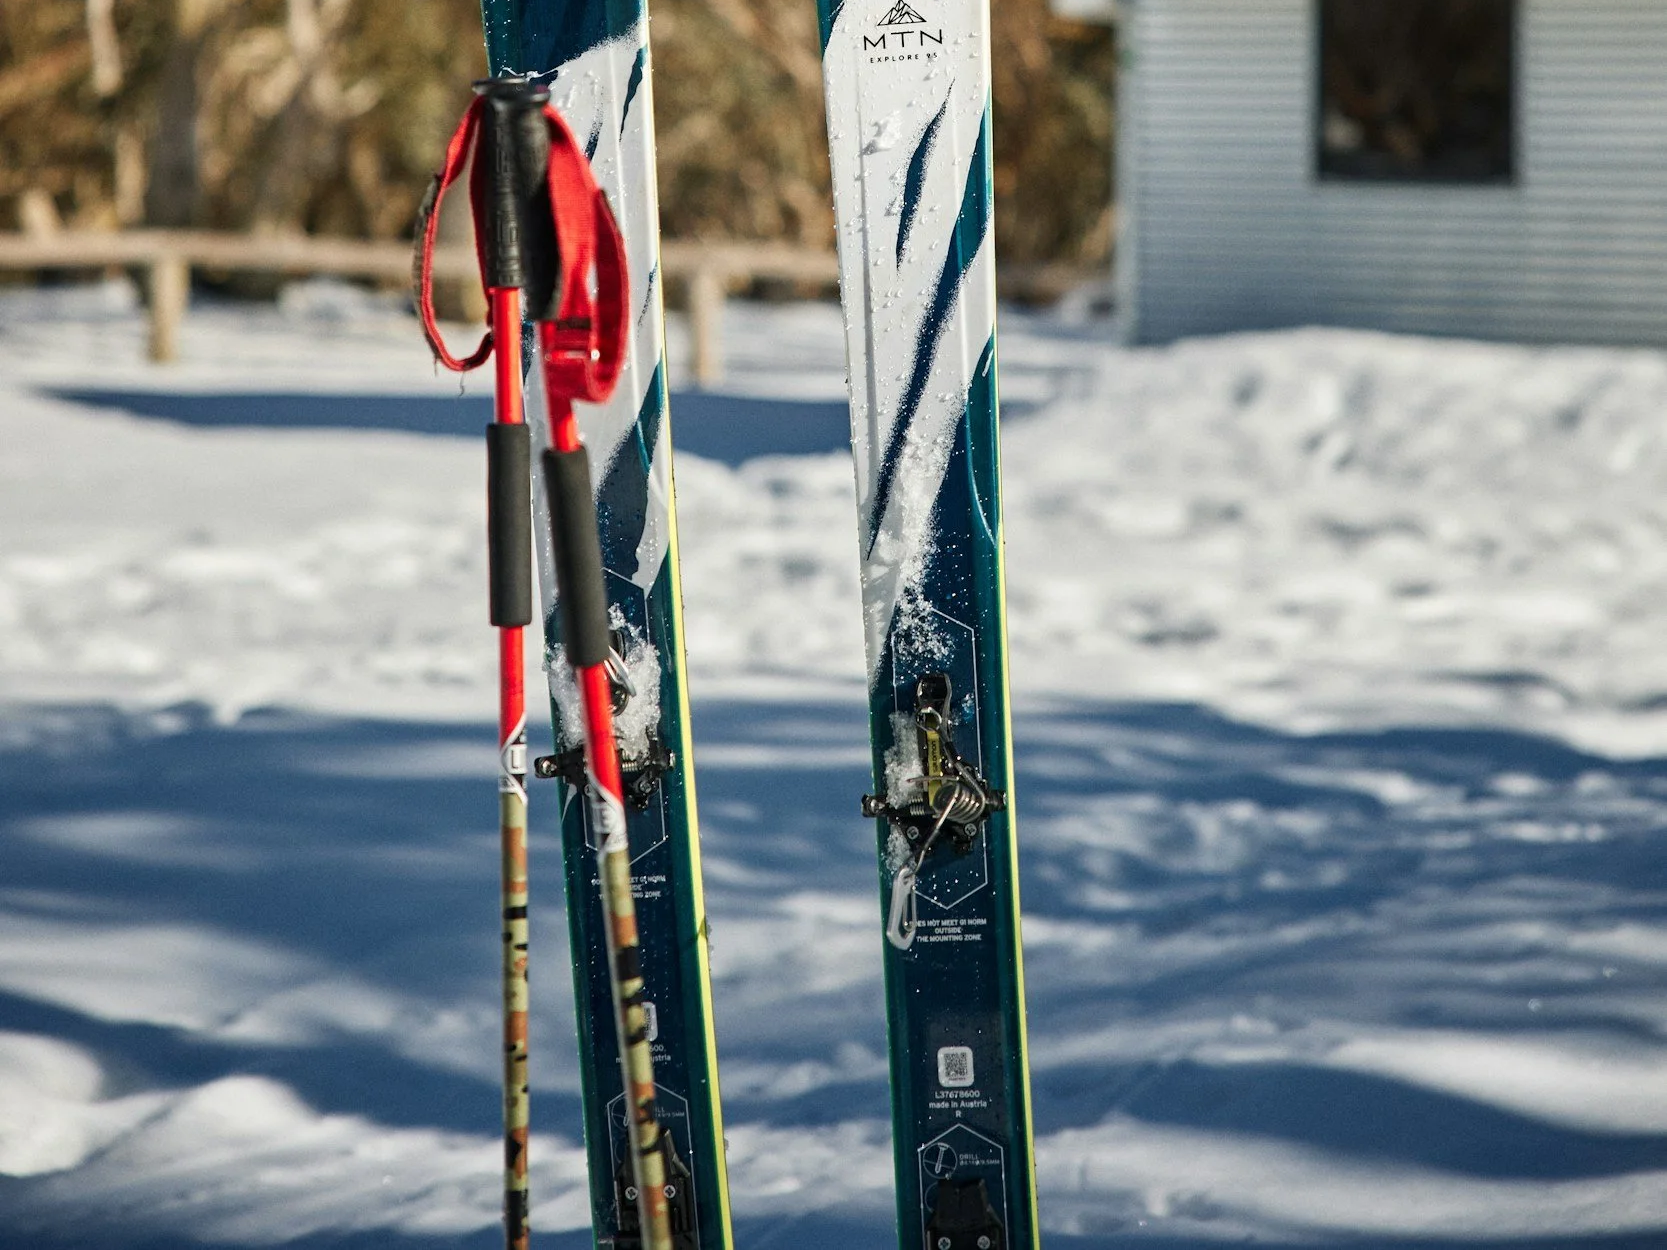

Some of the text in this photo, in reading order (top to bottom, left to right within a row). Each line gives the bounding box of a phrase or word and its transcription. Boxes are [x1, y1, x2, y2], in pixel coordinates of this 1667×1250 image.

[863, 29, 943, 51] MTN
[870, 54, 920, 63] EXPLORE
[927, 919, 940, 927] NOT
[960, 1100, 987, 1108] Austria
[955, 1110, 962, 1118] R
